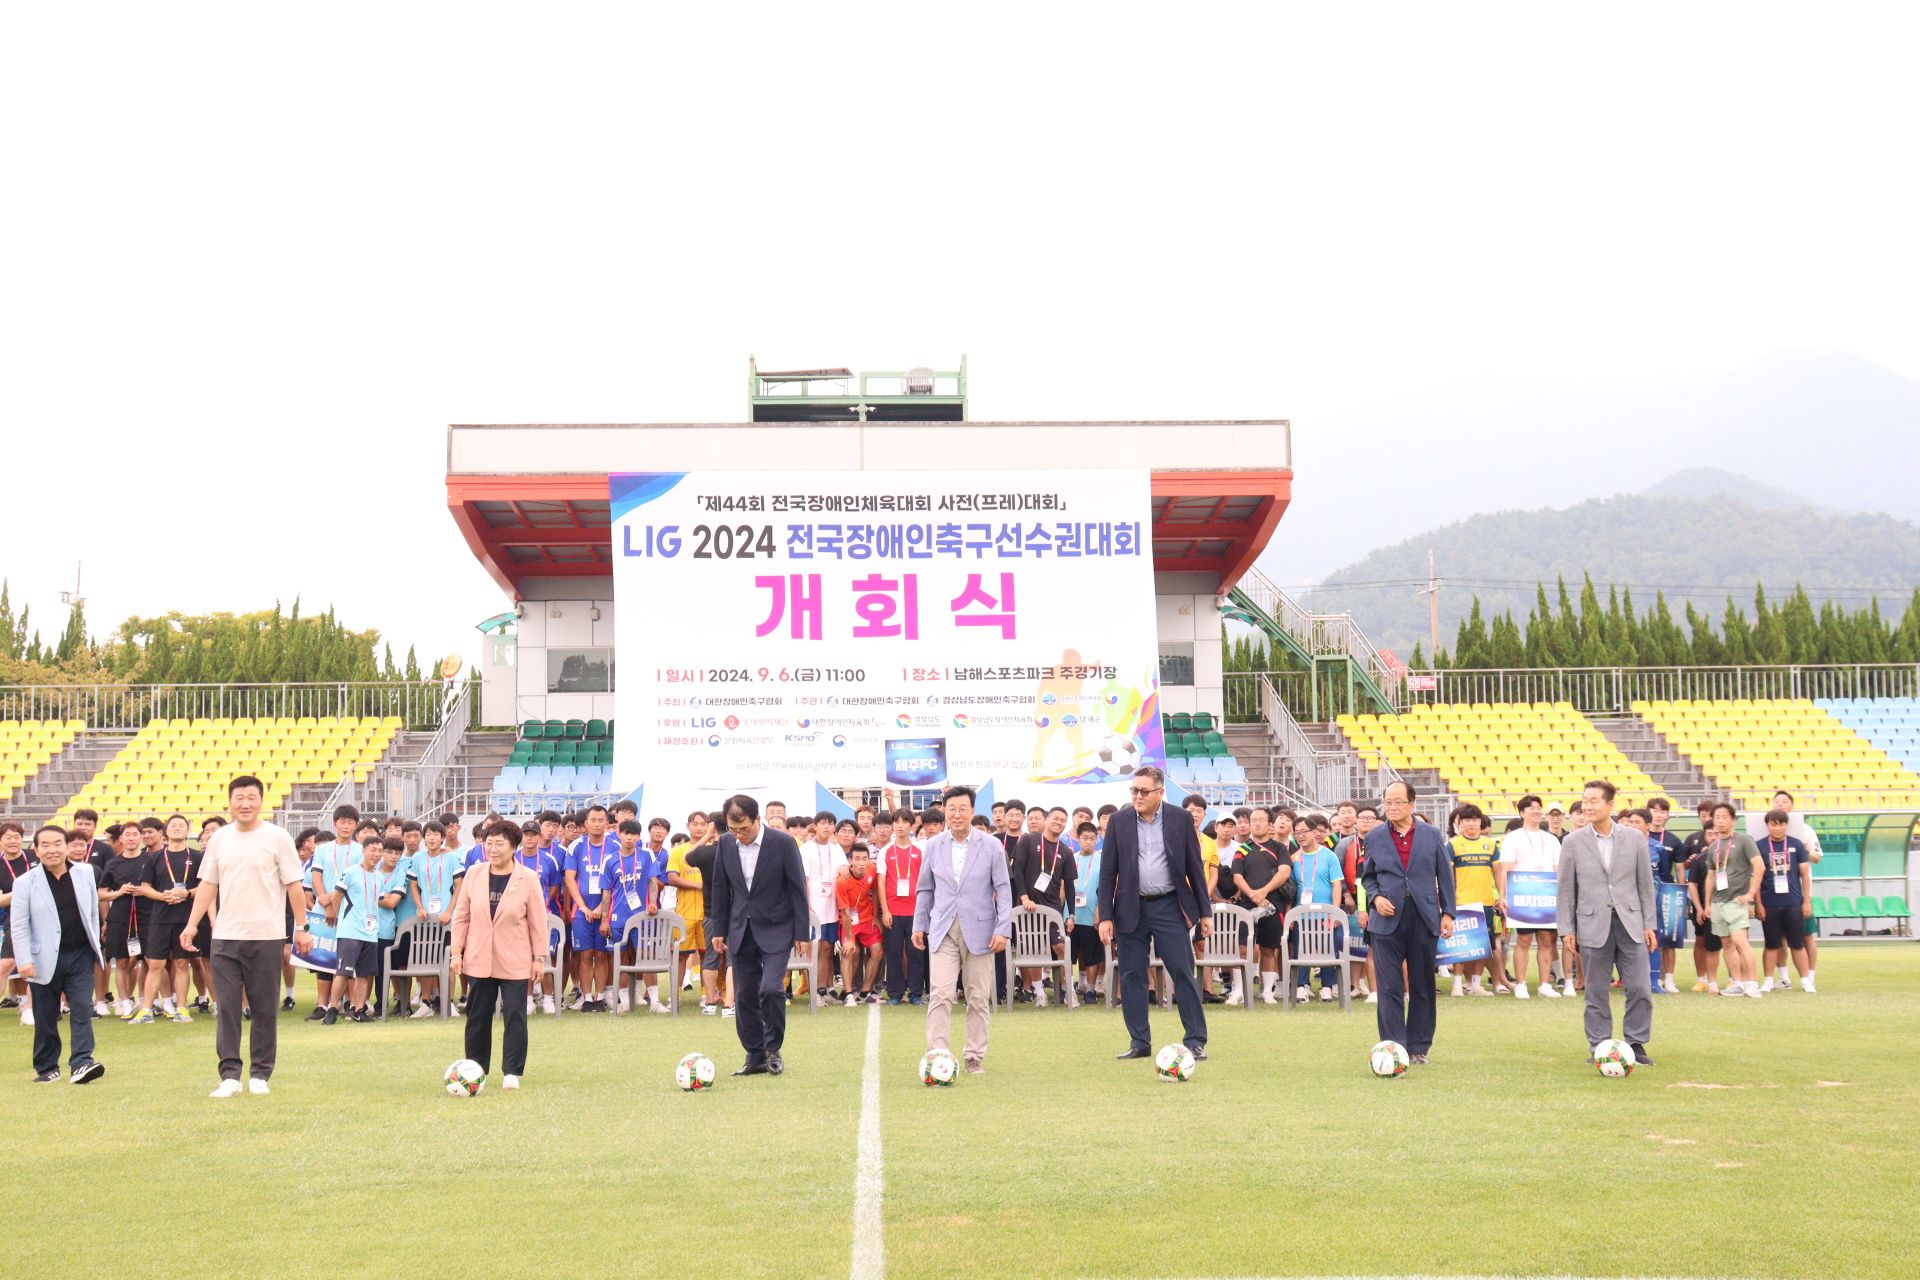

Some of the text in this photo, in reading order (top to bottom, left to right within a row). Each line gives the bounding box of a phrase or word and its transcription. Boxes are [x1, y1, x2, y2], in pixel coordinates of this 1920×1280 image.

[697, 493, 1067, 512] 「제44회 전국장애인체육대회 사전(프레)대회」
[623, 521, 1141, 559] LIG 2024 전국장애인축구선수권대회
[708, 669, 753, 682] 2024.
[825, 668, 866, 682] 11:00
[954, 667, 1056, 681] 남해스포츠파크
[1059, 666, 1118, 680] 주경기장
[705, 697, 783, 706] 대한장애인축구협회
[842, 696, 919, 706] 대한장애인축구협회
[942, 695, 1036, 705] 경상남도장애인축구협회
[691, 717, 717, 728] LIG
[784, 734, 816, 743] KSPO
